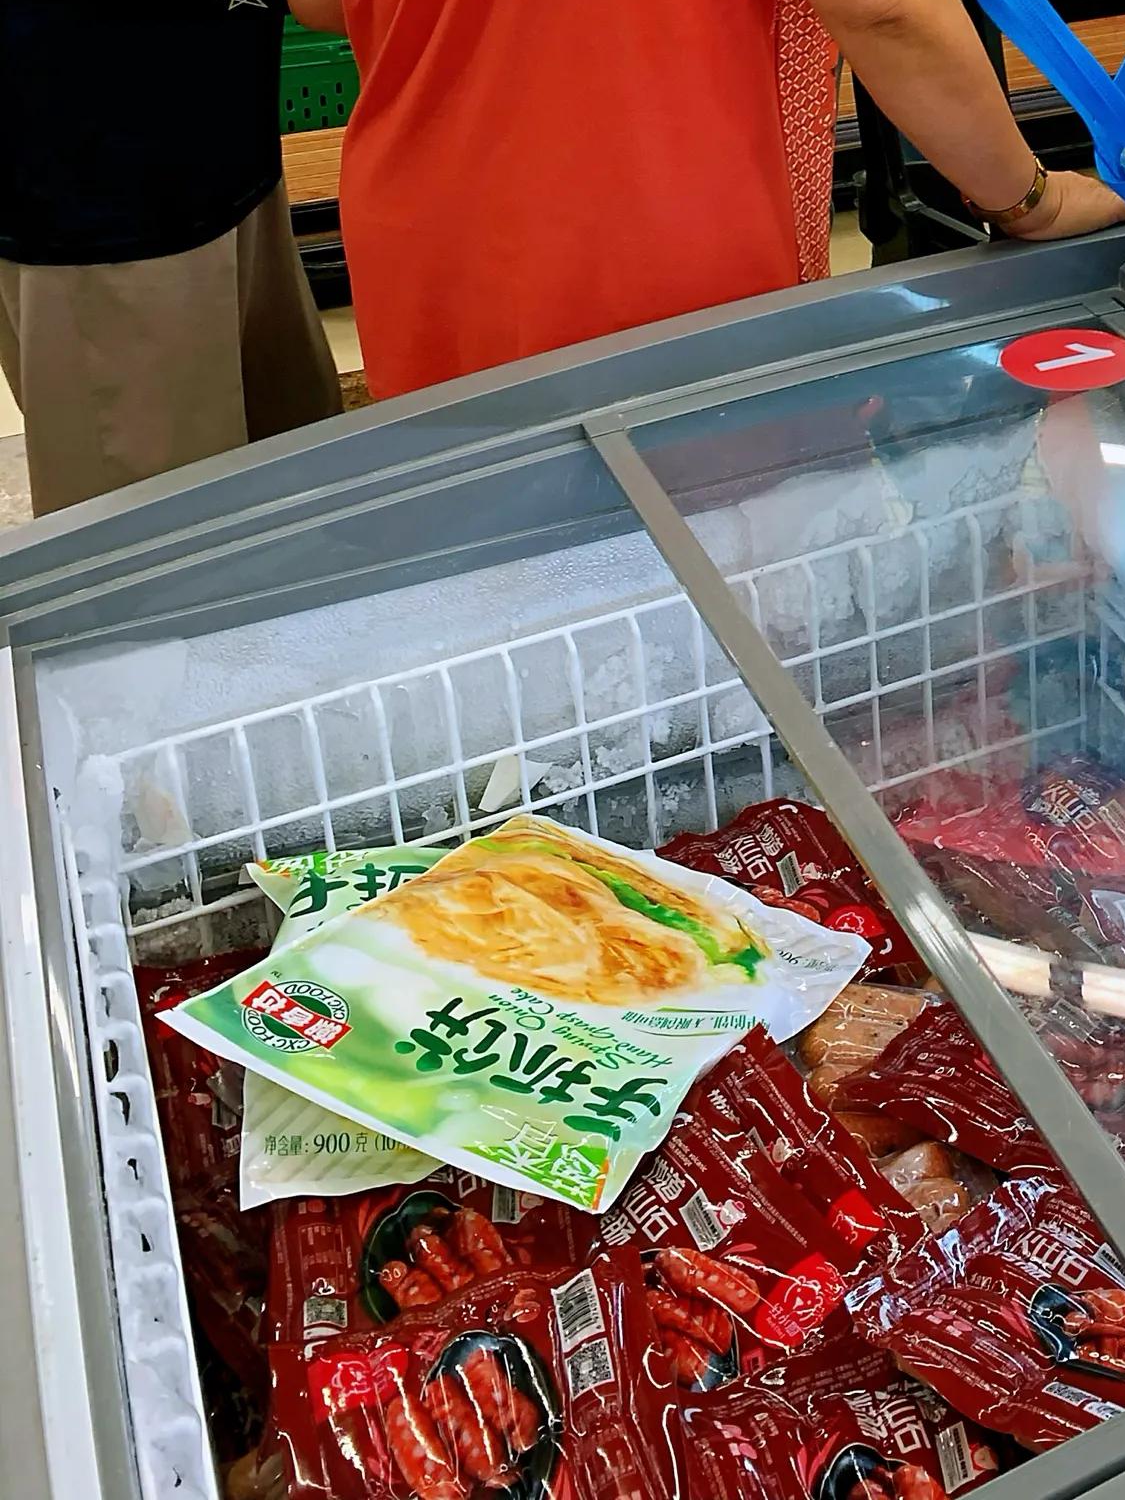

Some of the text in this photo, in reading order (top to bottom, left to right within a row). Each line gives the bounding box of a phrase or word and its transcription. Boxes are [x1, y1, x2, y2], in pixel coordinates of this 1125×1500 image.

[510, 987, 555, 1015] Cake
[488, 993, 636, 1070] Spring Onion
[394, 997, 668, 1142] 手抓饼
[313, 1132, 351, 1155] 900
